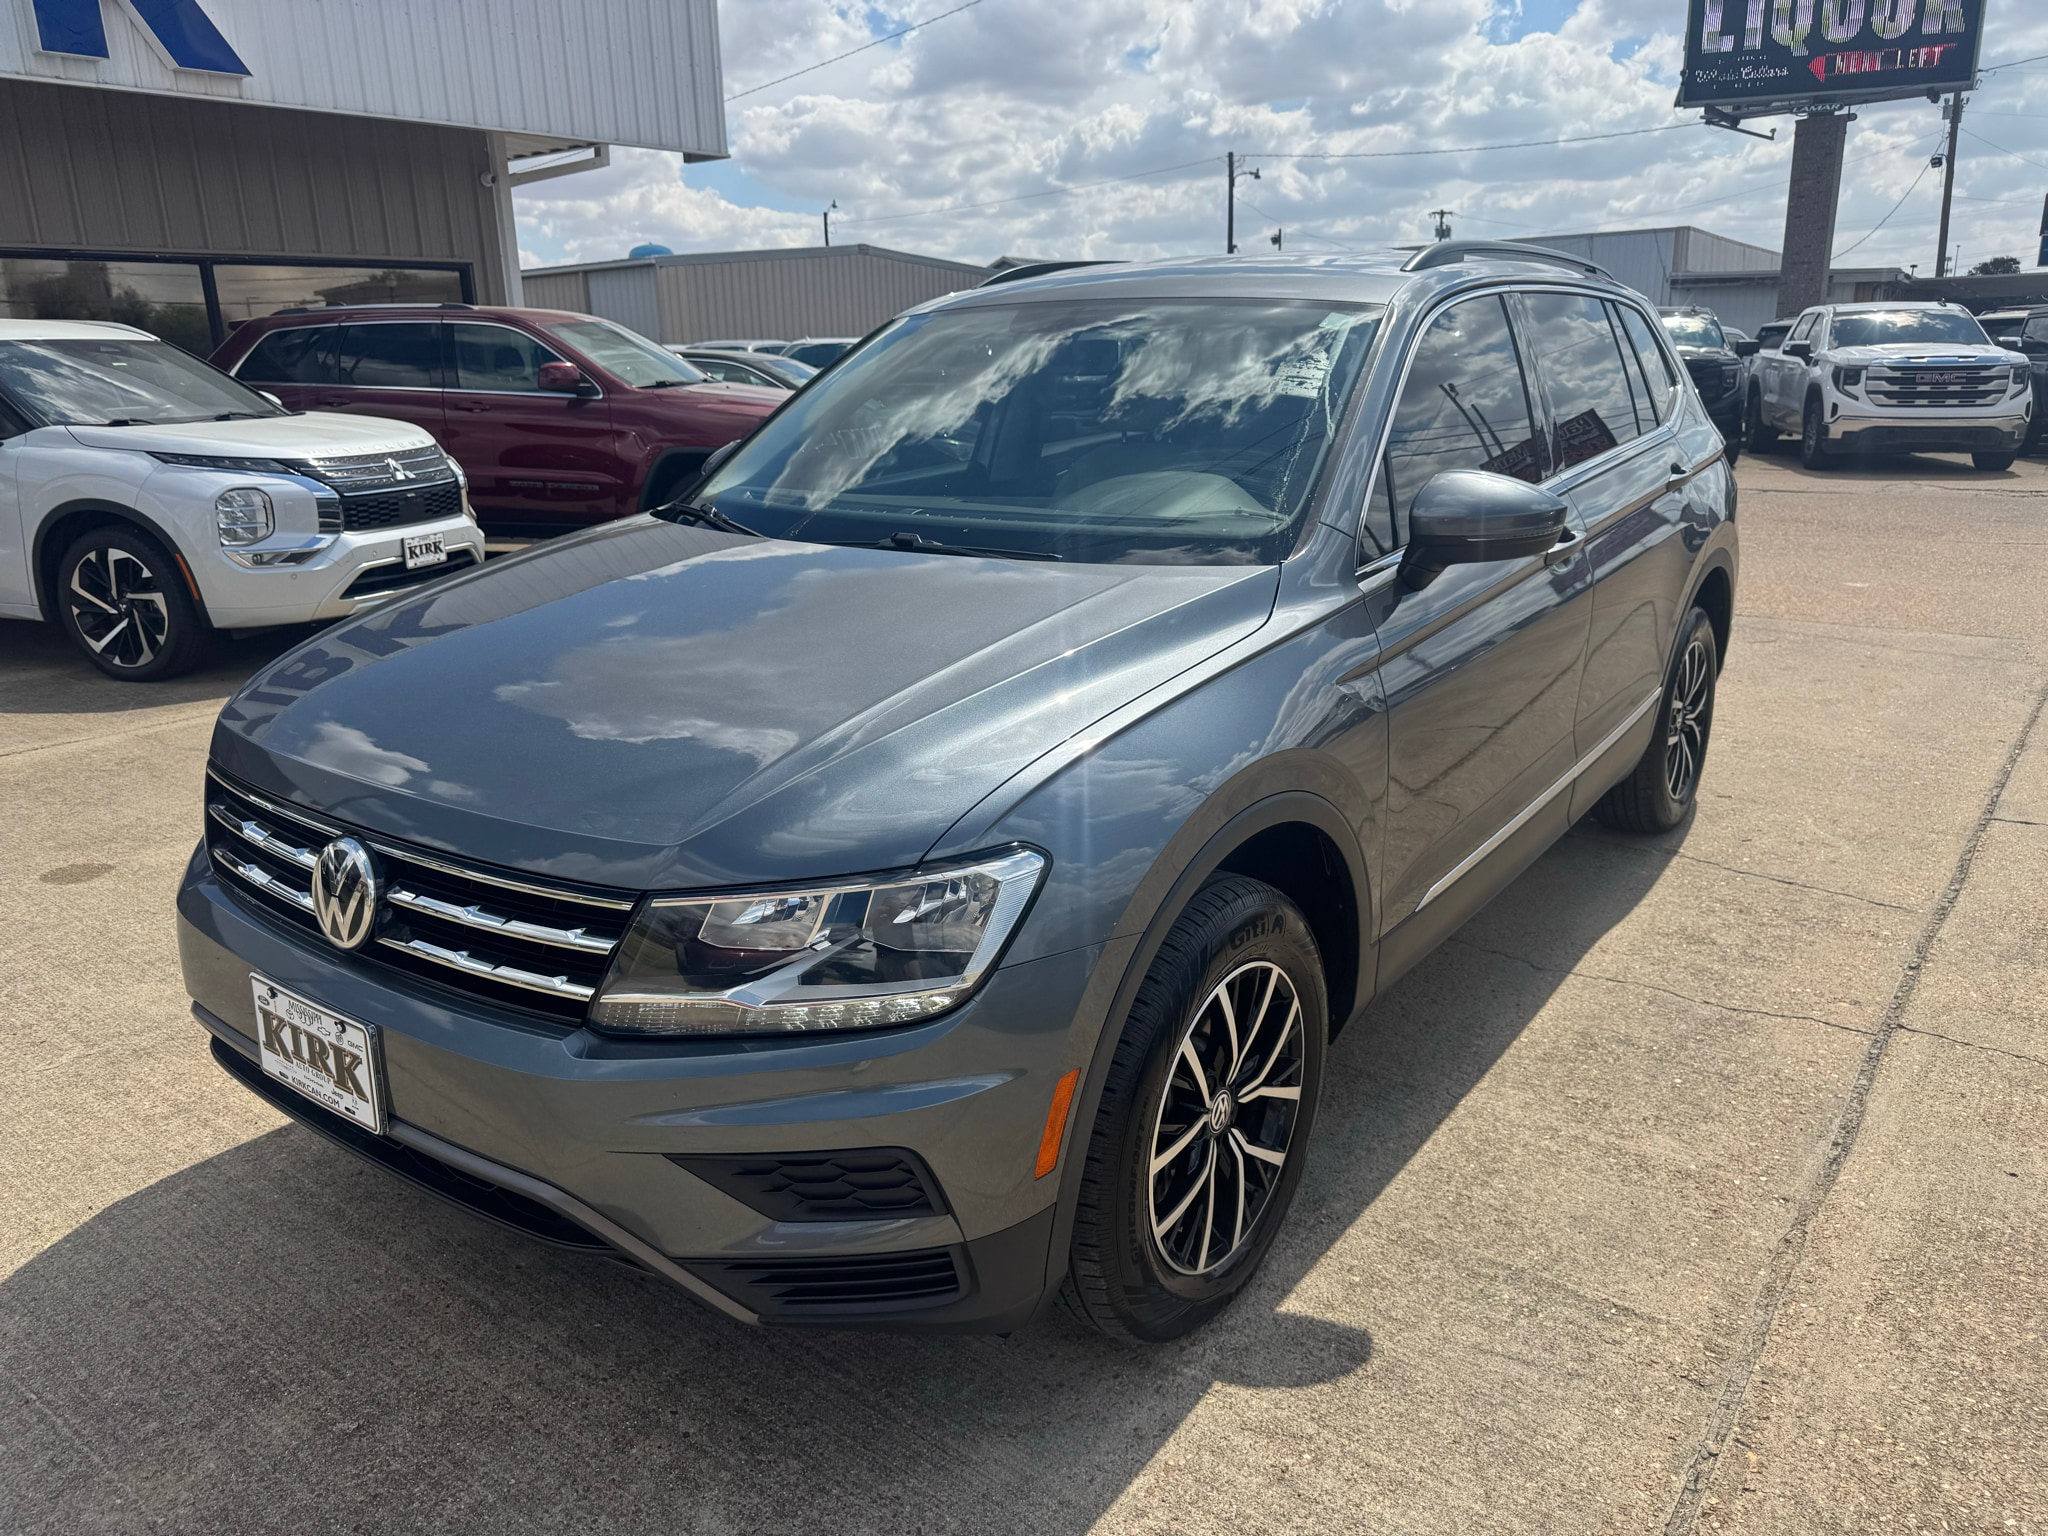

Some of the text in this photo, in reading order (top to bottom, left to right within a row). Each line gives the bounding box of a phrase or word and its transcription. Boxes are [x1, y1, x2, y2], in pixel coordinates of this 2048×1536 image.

[1895, 46, 1944, 69] LEFT
[1792, 103, 1841, 113] LAMAR
[1915, 372, 1967, 383] GMC
[407, 540, 444, 560] KIRK
[258, 1004, 369, 1104] KIRK
[347, 1040, 364, 1052] GMC
